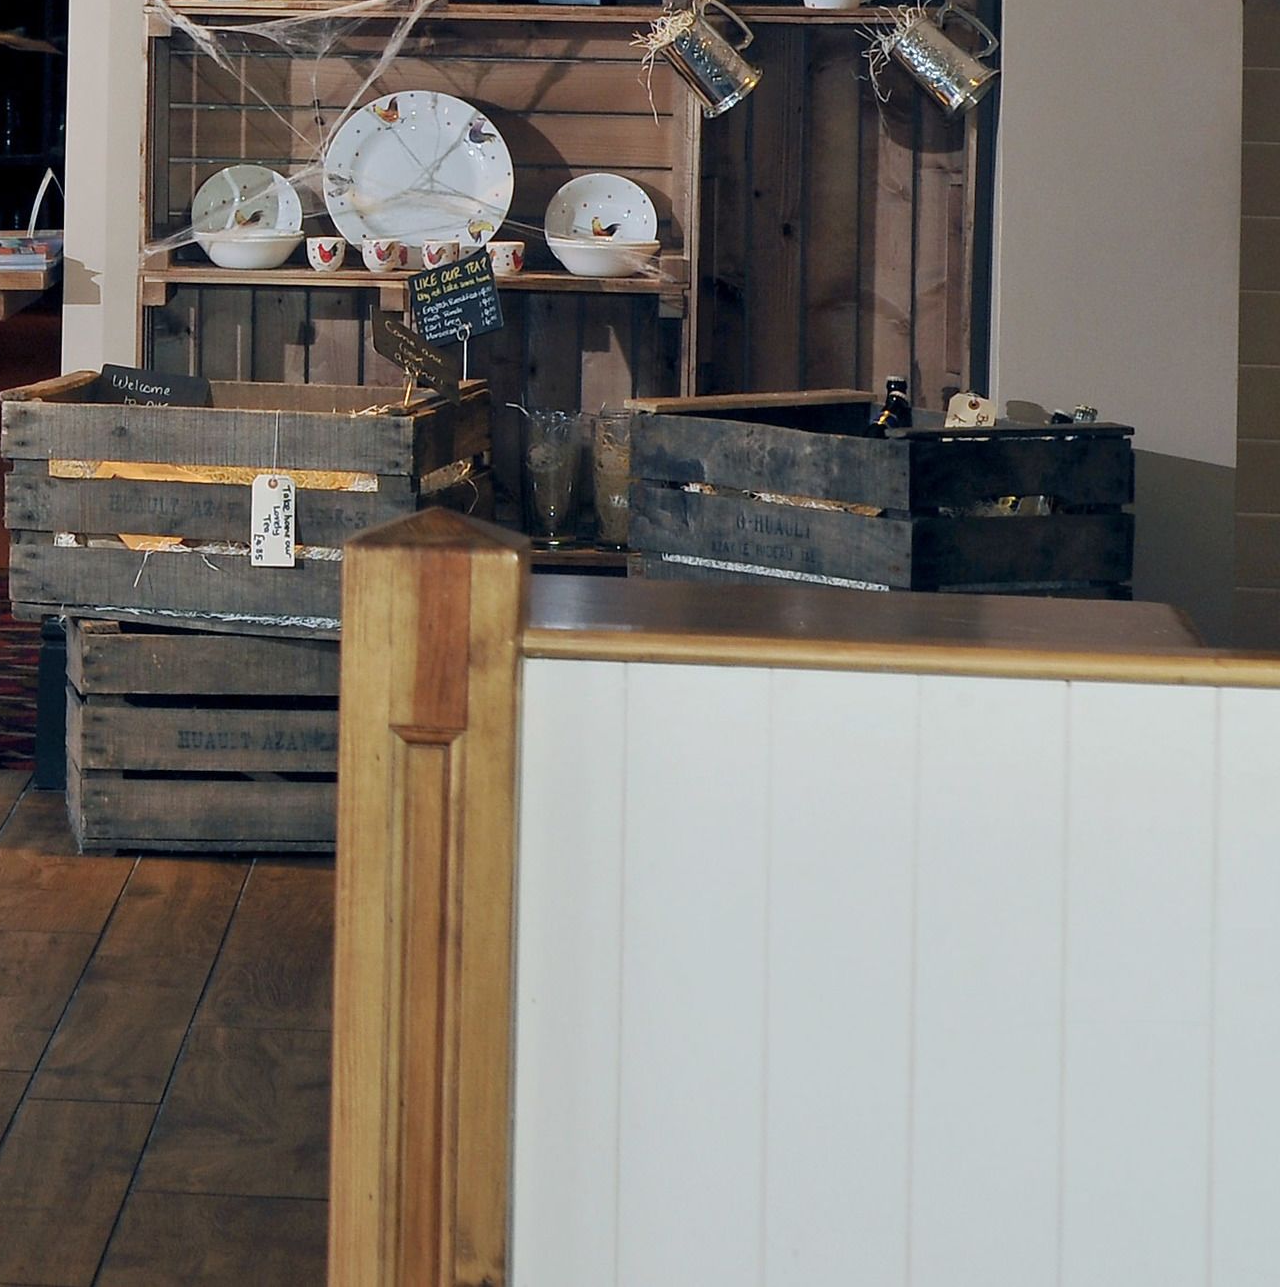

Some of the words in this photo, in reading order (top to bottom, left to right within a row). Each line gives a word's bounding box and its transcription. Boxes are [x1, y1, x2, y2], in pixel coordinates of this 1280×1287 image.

[414, 273, 438, 291] LIKE
[441, 266, 463, 283] OUR
[464, 257, 487, 274] TEA?
[112, 374, 172, 396] Welcome
[124, 395, 137, 406] to
[282, 485, 293, 512] Take
[263, 514, 272, 533] Tea
[283, 514, 293, 539] home
